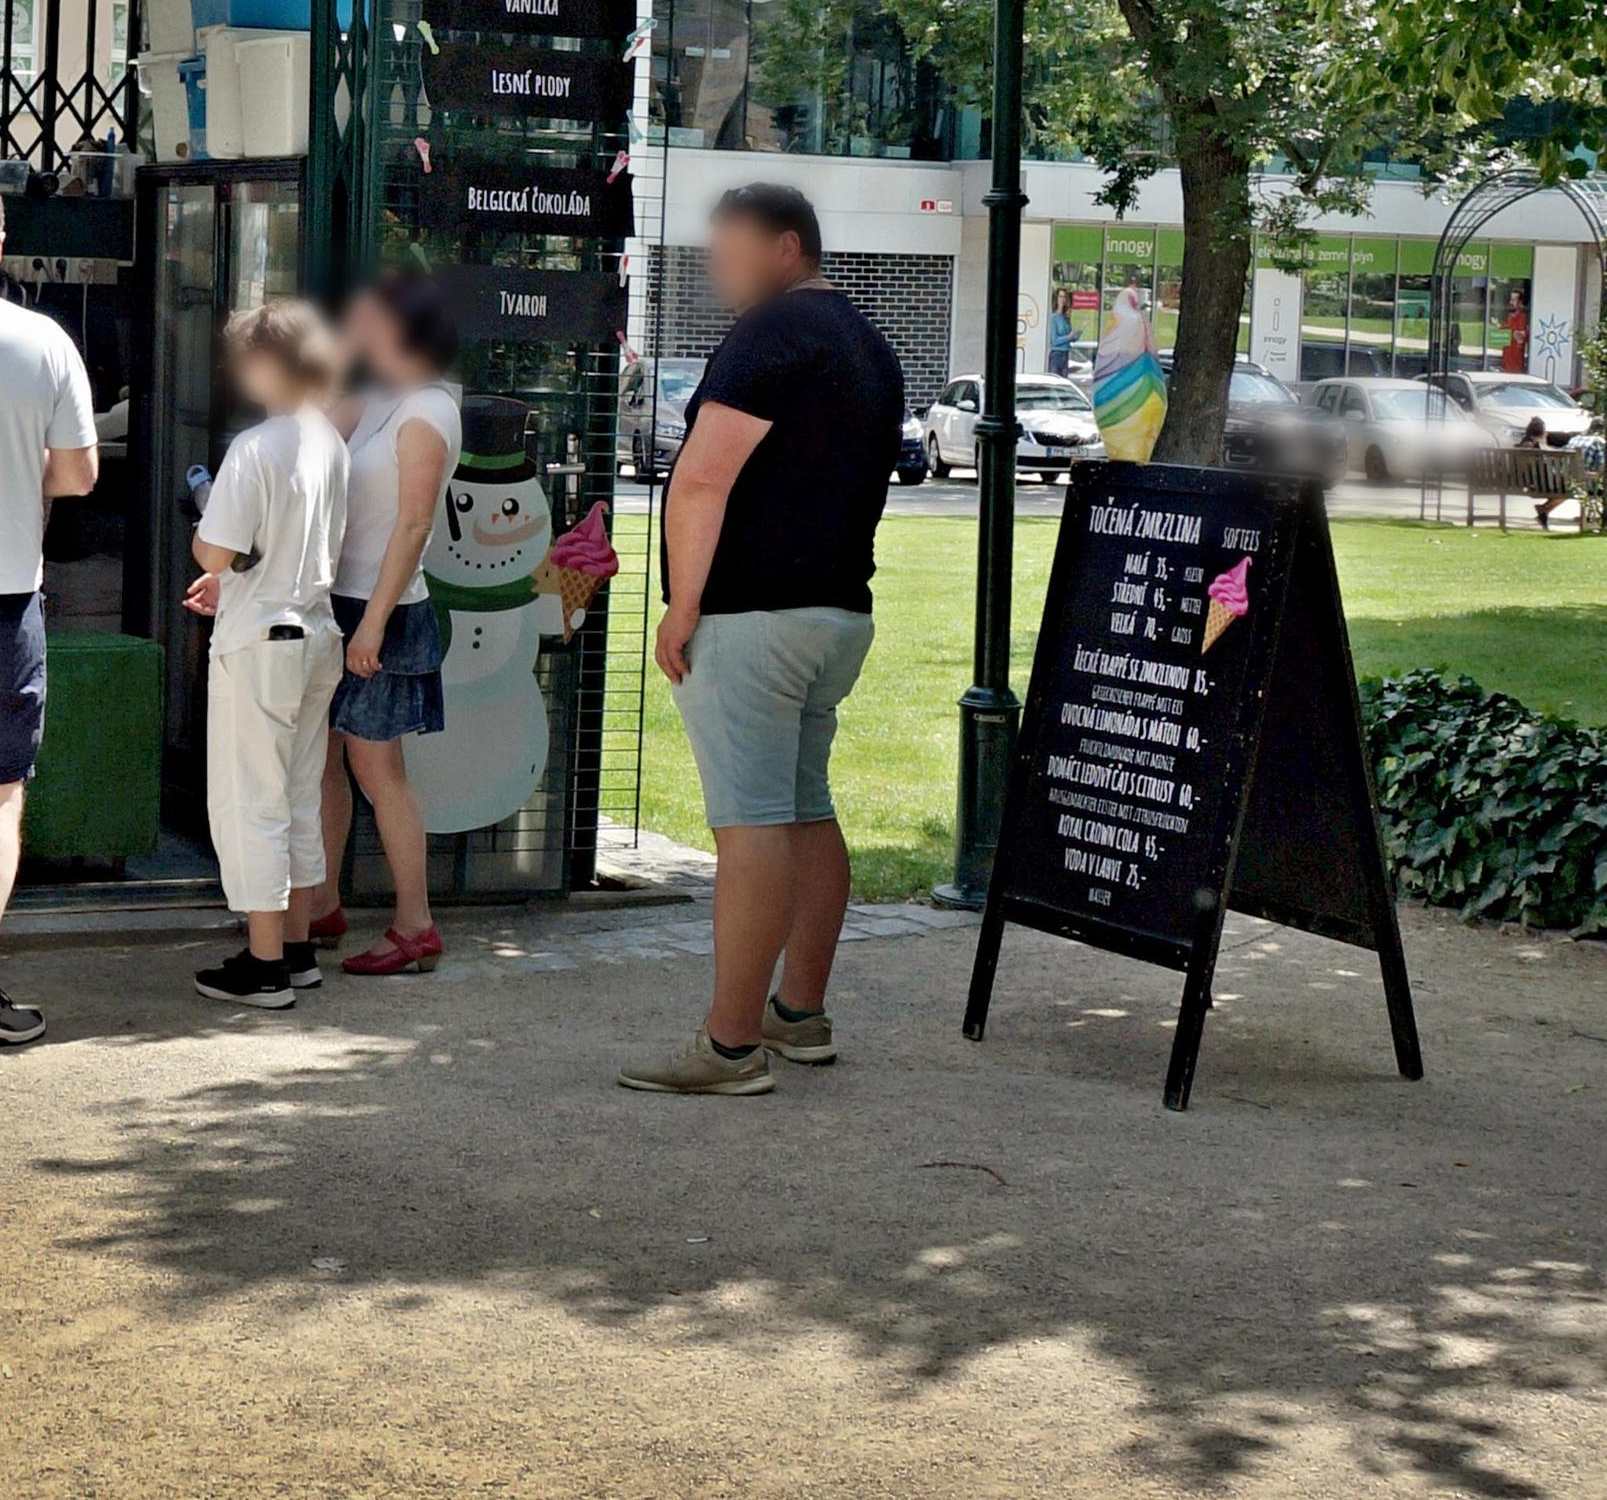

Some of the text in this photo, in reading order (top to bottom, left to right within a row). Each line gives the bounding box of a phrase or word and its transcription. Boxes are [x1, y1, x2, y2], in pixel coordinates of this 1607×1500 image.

[492, 69, 571, 98] LESNÍ PLODY
[468, 185, 591, 216] BELGICKÁ ČOKOLÁDA
[1106, 235, 1153, 257] innogy
[500, 290, 547, 317] TVAROH
[1089, 496, 1261, 552] TOČENÁ ZMRZLINA SOFTEIS
[1124, 551, 1151, 576] MALÁ
[1154, 557, 1175, 581] 35,-
[1111, 576, 1149, 606] STŘEDNÍ
[1110, 610, 1138, 636] VELKÁ
[1144, 616, 1163, 641] 70,-
[1073, 644, 1216, 696] ŘECKÉ FRAPPÉ SE ZMRZLINOU 85,-
[1061, 702, 1208, 753] OVOCNÁ LIMONÁDA S MÁTOU 60,-
[1080, 763, 1114, 789] LEDOVÝ
[1110, 763, 1128, 795] ČAJ
[1127, 772, 1136, 795] S
[1135, 774, 1175, 804] CITRUSY
[1179, 783, 1201, 811] 60,-
[1058, 813, 1165, 861] ROYAL CROWN COLA 45,-
[1064, 847, 1087, 873] VODA
[1088, 853, 1096, 875] V
[1125, 863, 1147, 890] 25,-
